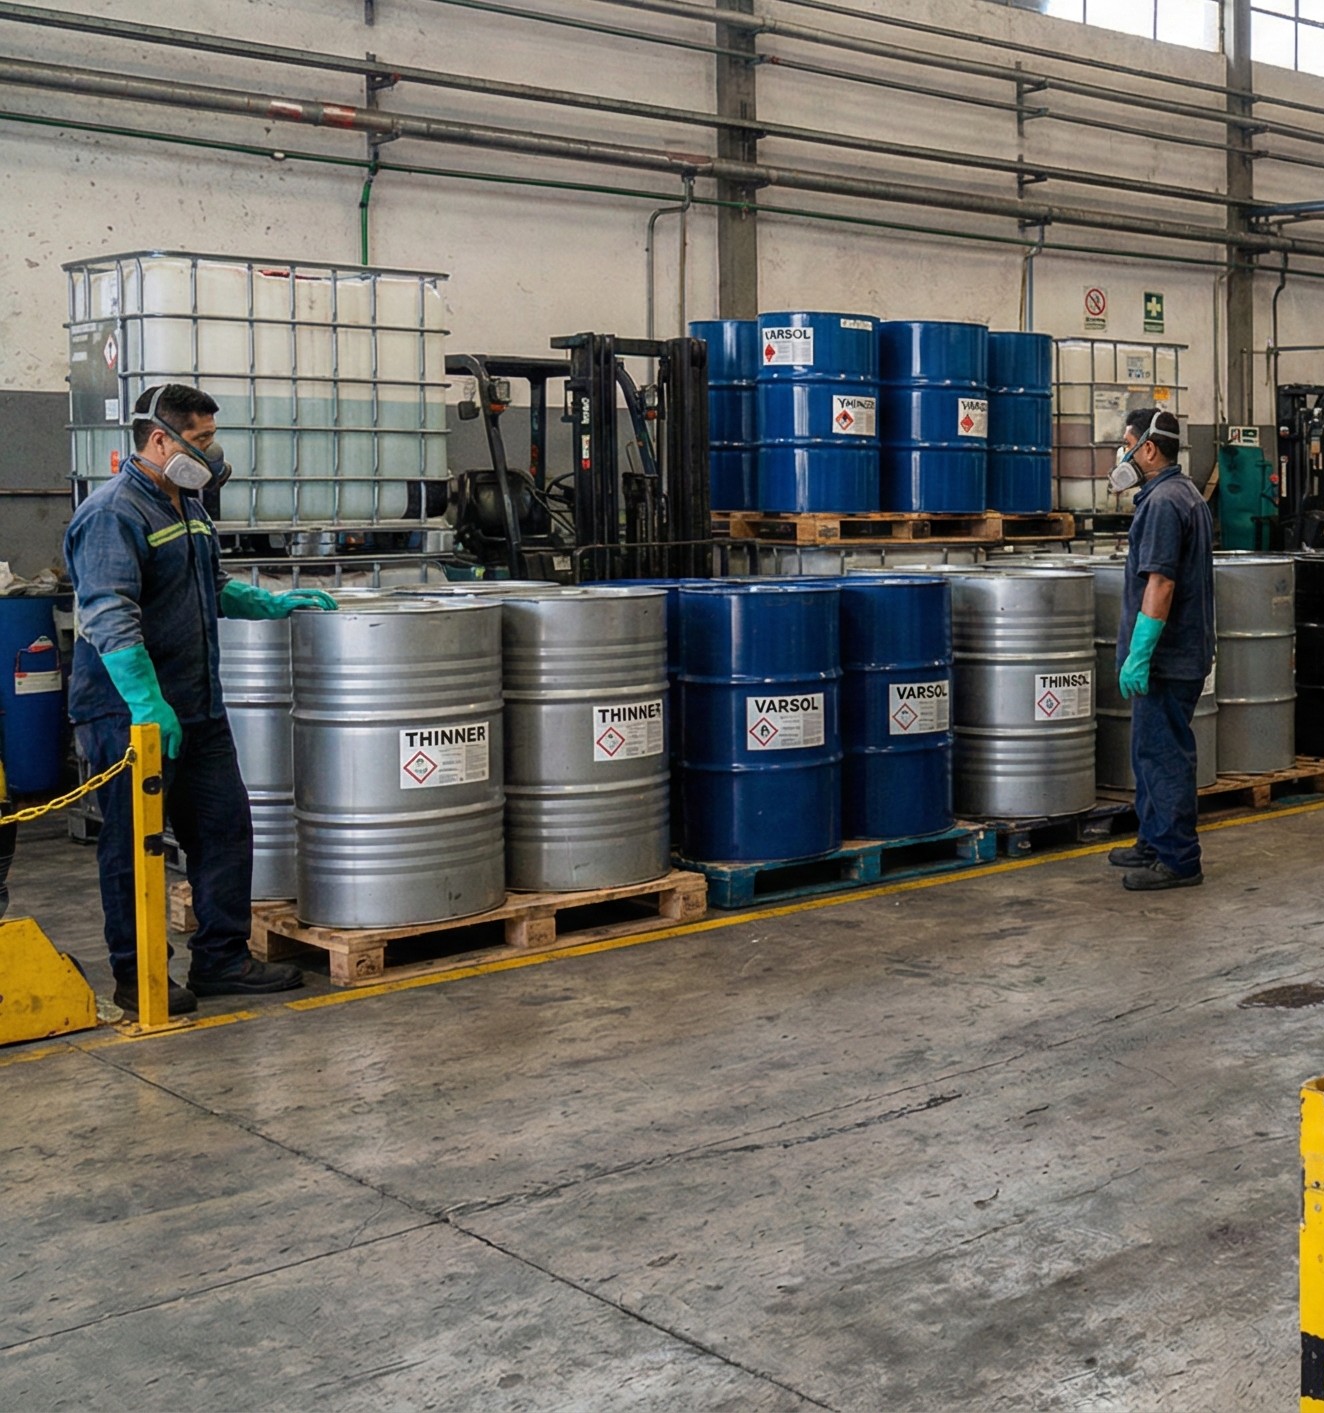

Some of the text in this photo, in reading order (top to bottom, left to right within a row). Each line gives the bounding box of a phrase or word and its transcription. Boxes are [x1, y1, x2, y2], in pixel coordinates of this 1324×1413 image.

[896, 684, 948, 700] VARSOL
[755, 696, 819, 714] VARSOL
[405, 726, 486, 748] THINNER
